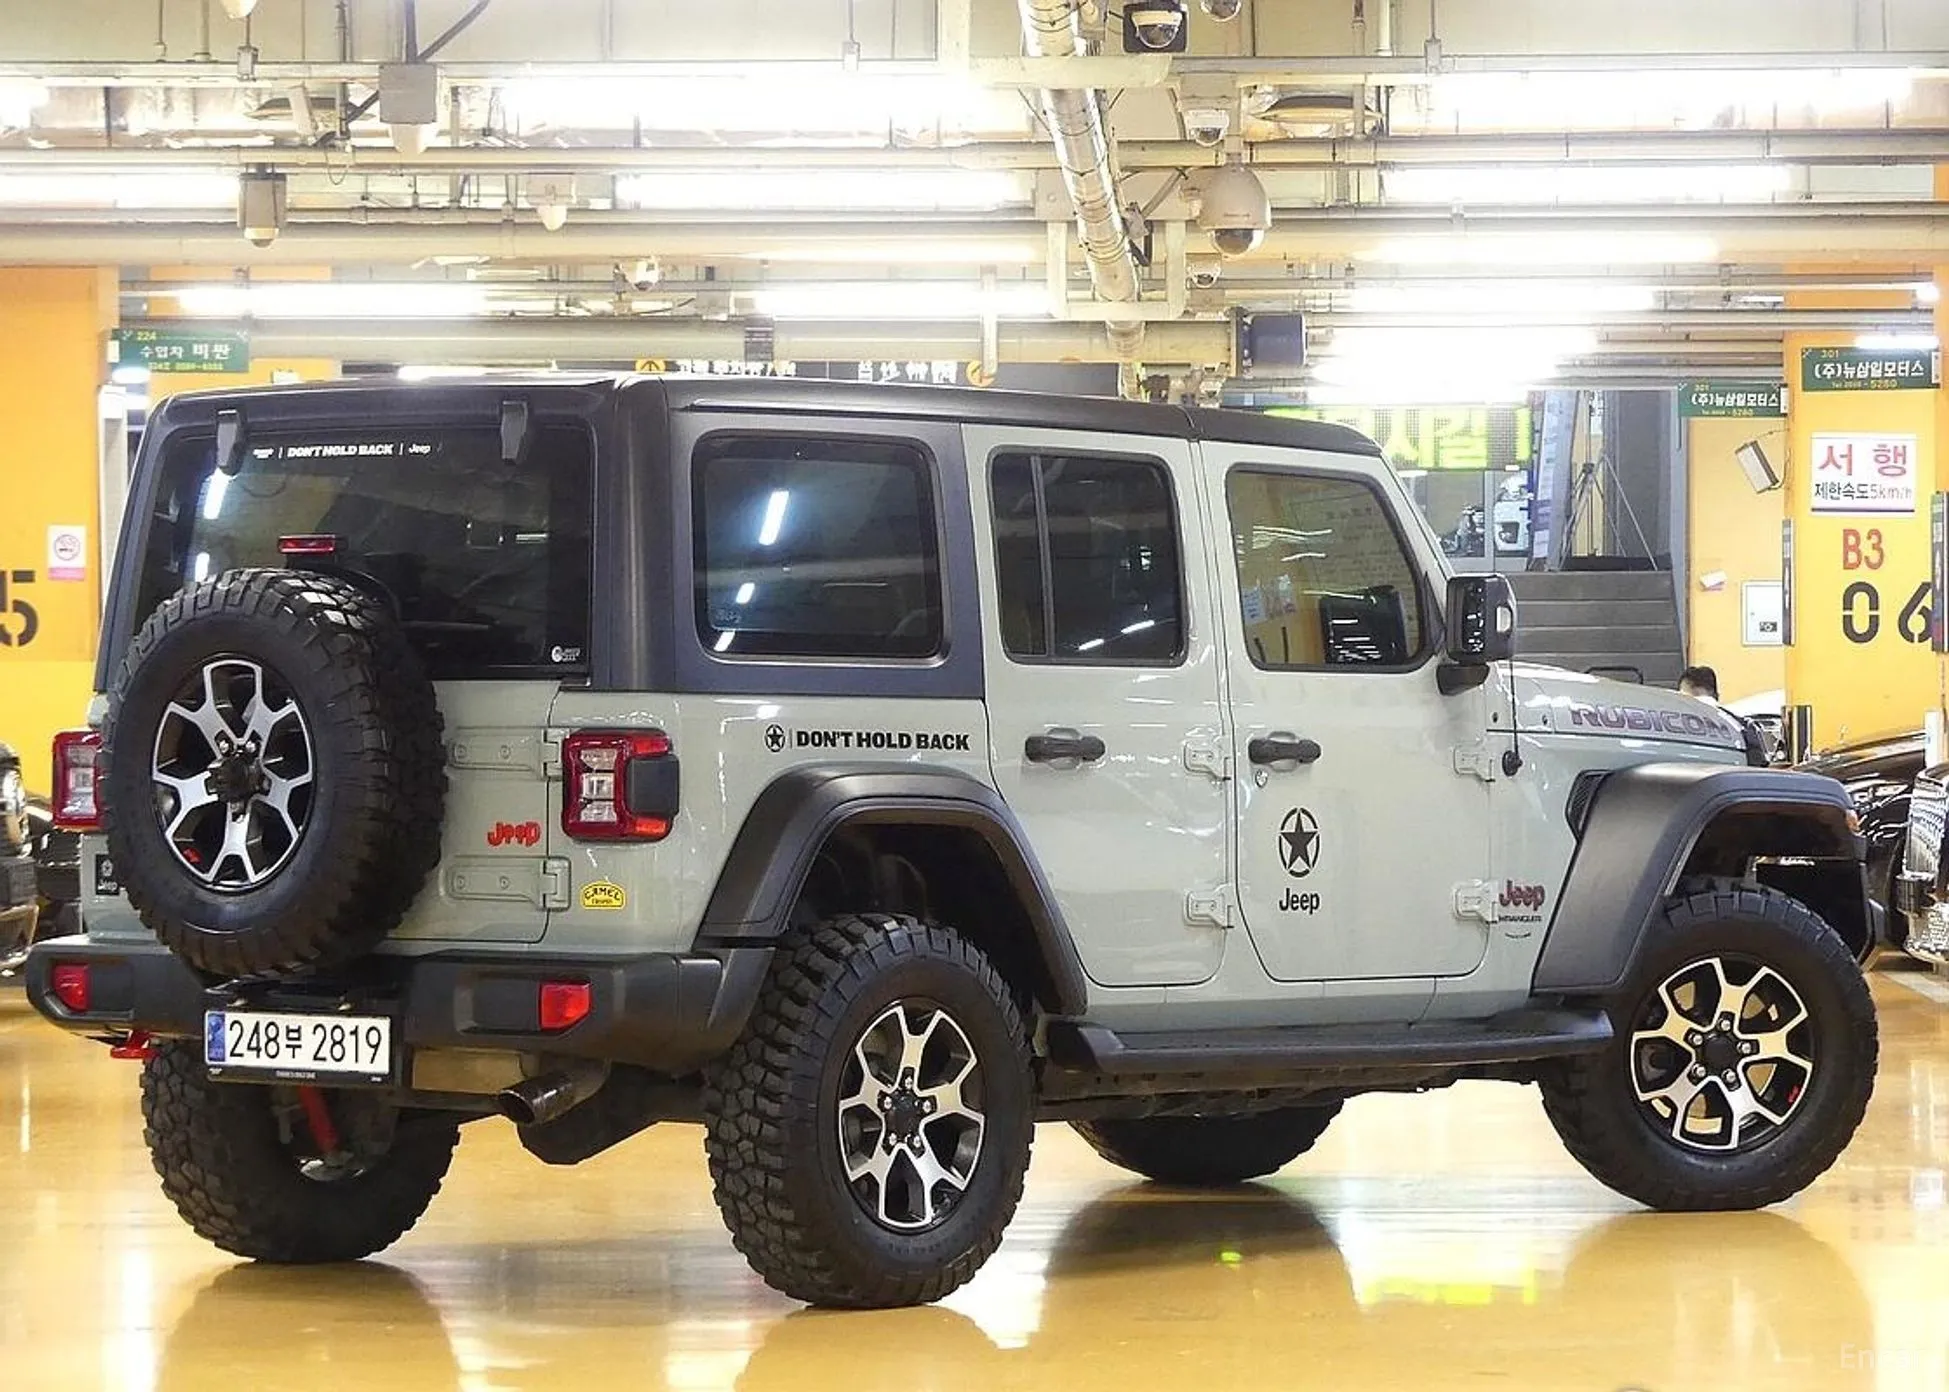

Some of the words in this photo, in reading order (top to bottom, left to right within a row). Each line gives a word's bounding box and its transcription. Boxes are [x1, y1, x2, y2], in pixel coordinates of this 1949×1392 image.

[1821, 349, 1840, 359] 301
[1814, 360, 1925, 379] (주)뉴삼일모터스
[1691, 392, 1780, 407] (주)뉴삼일모터스
[320, 445, 358, 457] HOLD
[358, 444, 394, 456] BACK
[1843, 528, 1885, 570] B3
[1569, 703, 1732, 739] RUBICON
[796, 731, 853, 748] DON'T
[856, 732, 912, 749] HOLD
[916, 733, 970, 750] BACK
[488, 821, 541, 847] Jeep
[584, 887, 622, 901] CAMEL
[1279, 888, 1320, 915] Jeep
[1499, 880, 1545, 911] Jeep
[229, 1020, 303, 1060] 248부
[312, 1023, 382, 1064] 2819
